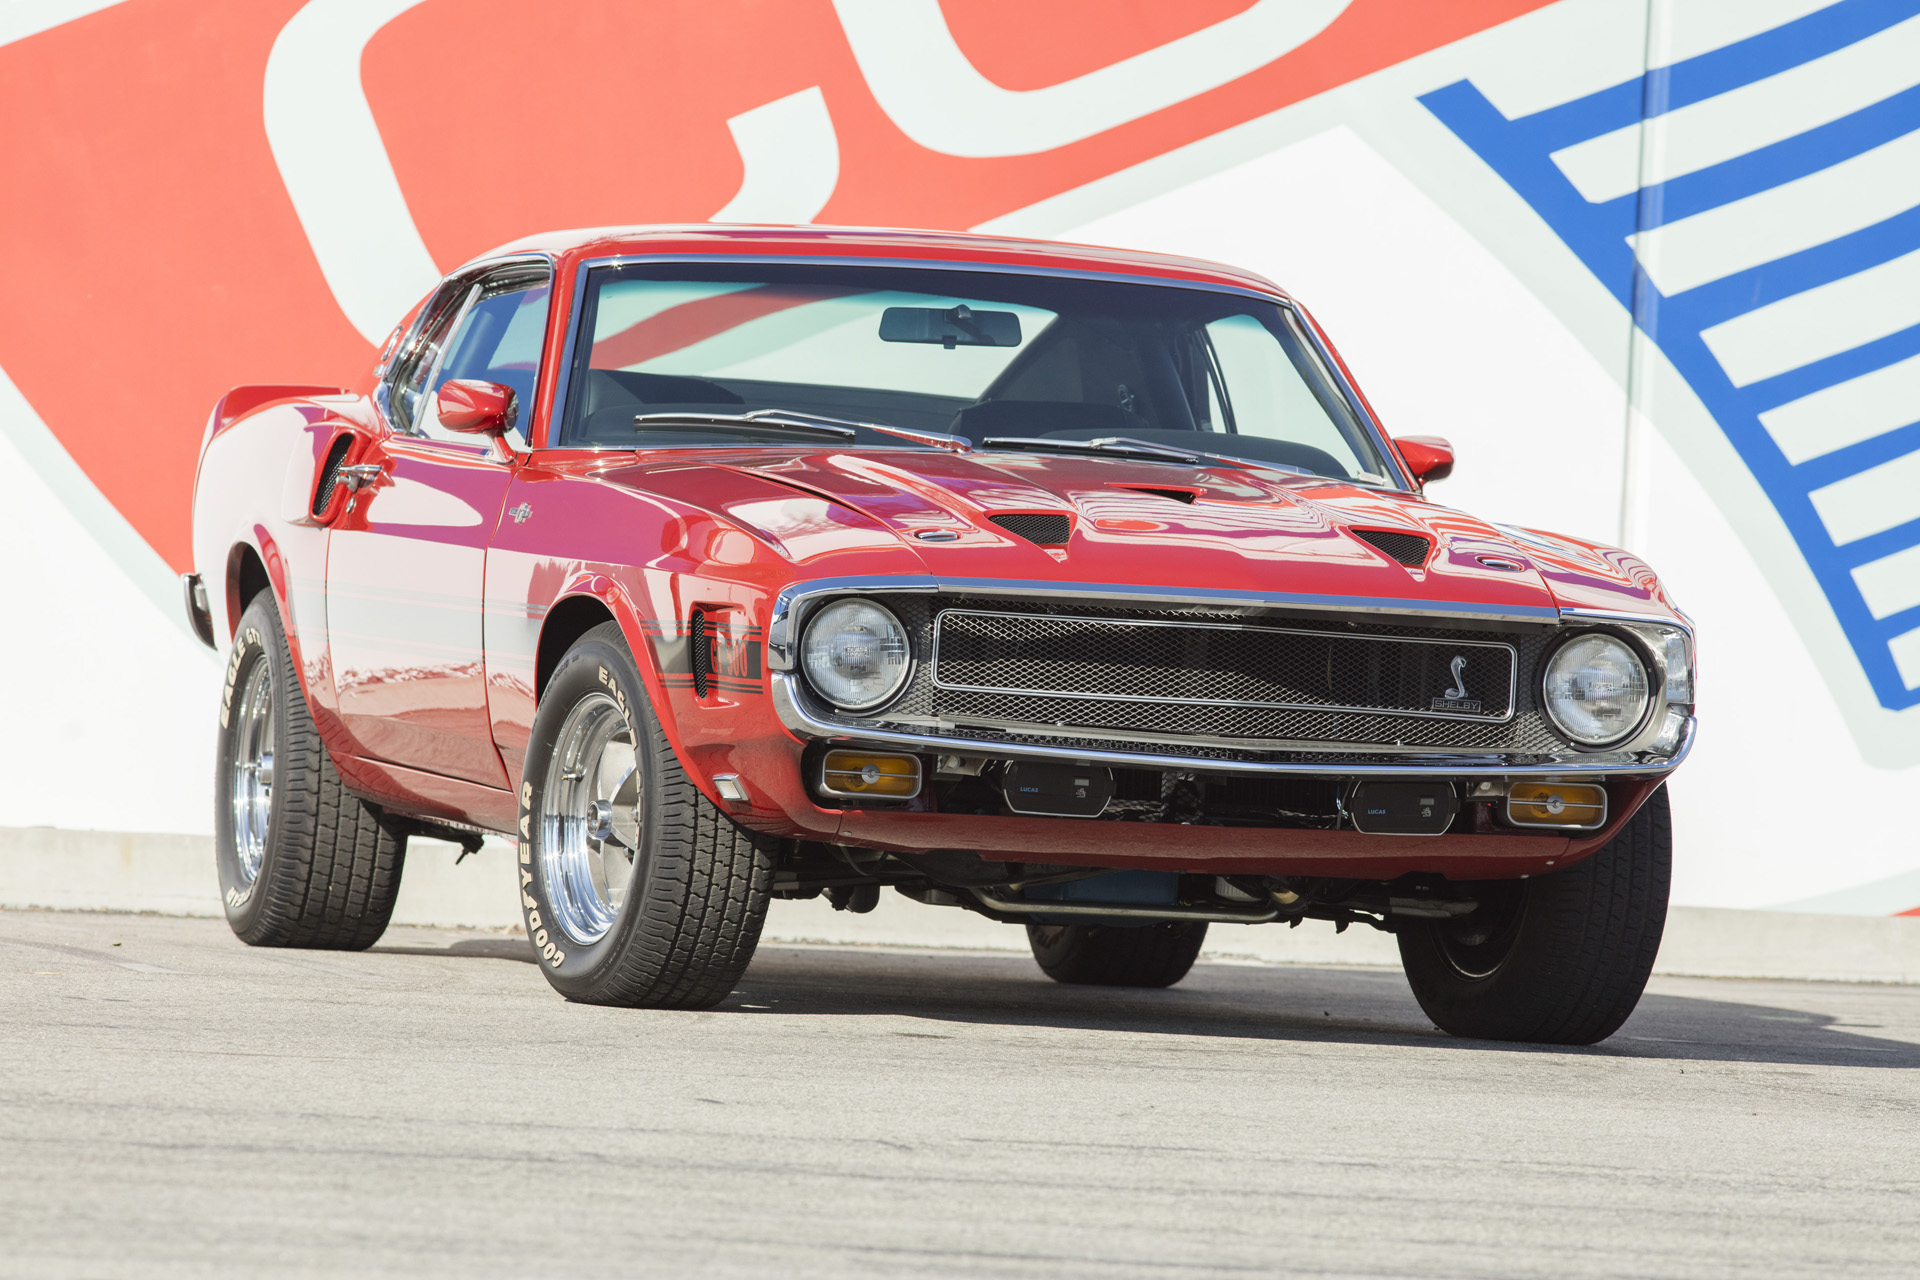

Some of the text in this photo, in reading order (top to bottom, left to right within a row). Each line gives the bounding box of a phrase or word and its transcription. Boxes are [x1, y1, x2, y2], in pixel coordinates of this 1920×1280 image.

[711, 638, 748, 677] GT 500
[1434, 700, 1479, 710] SHELBY
[520, 781, 566, 968] GOODYEAR
